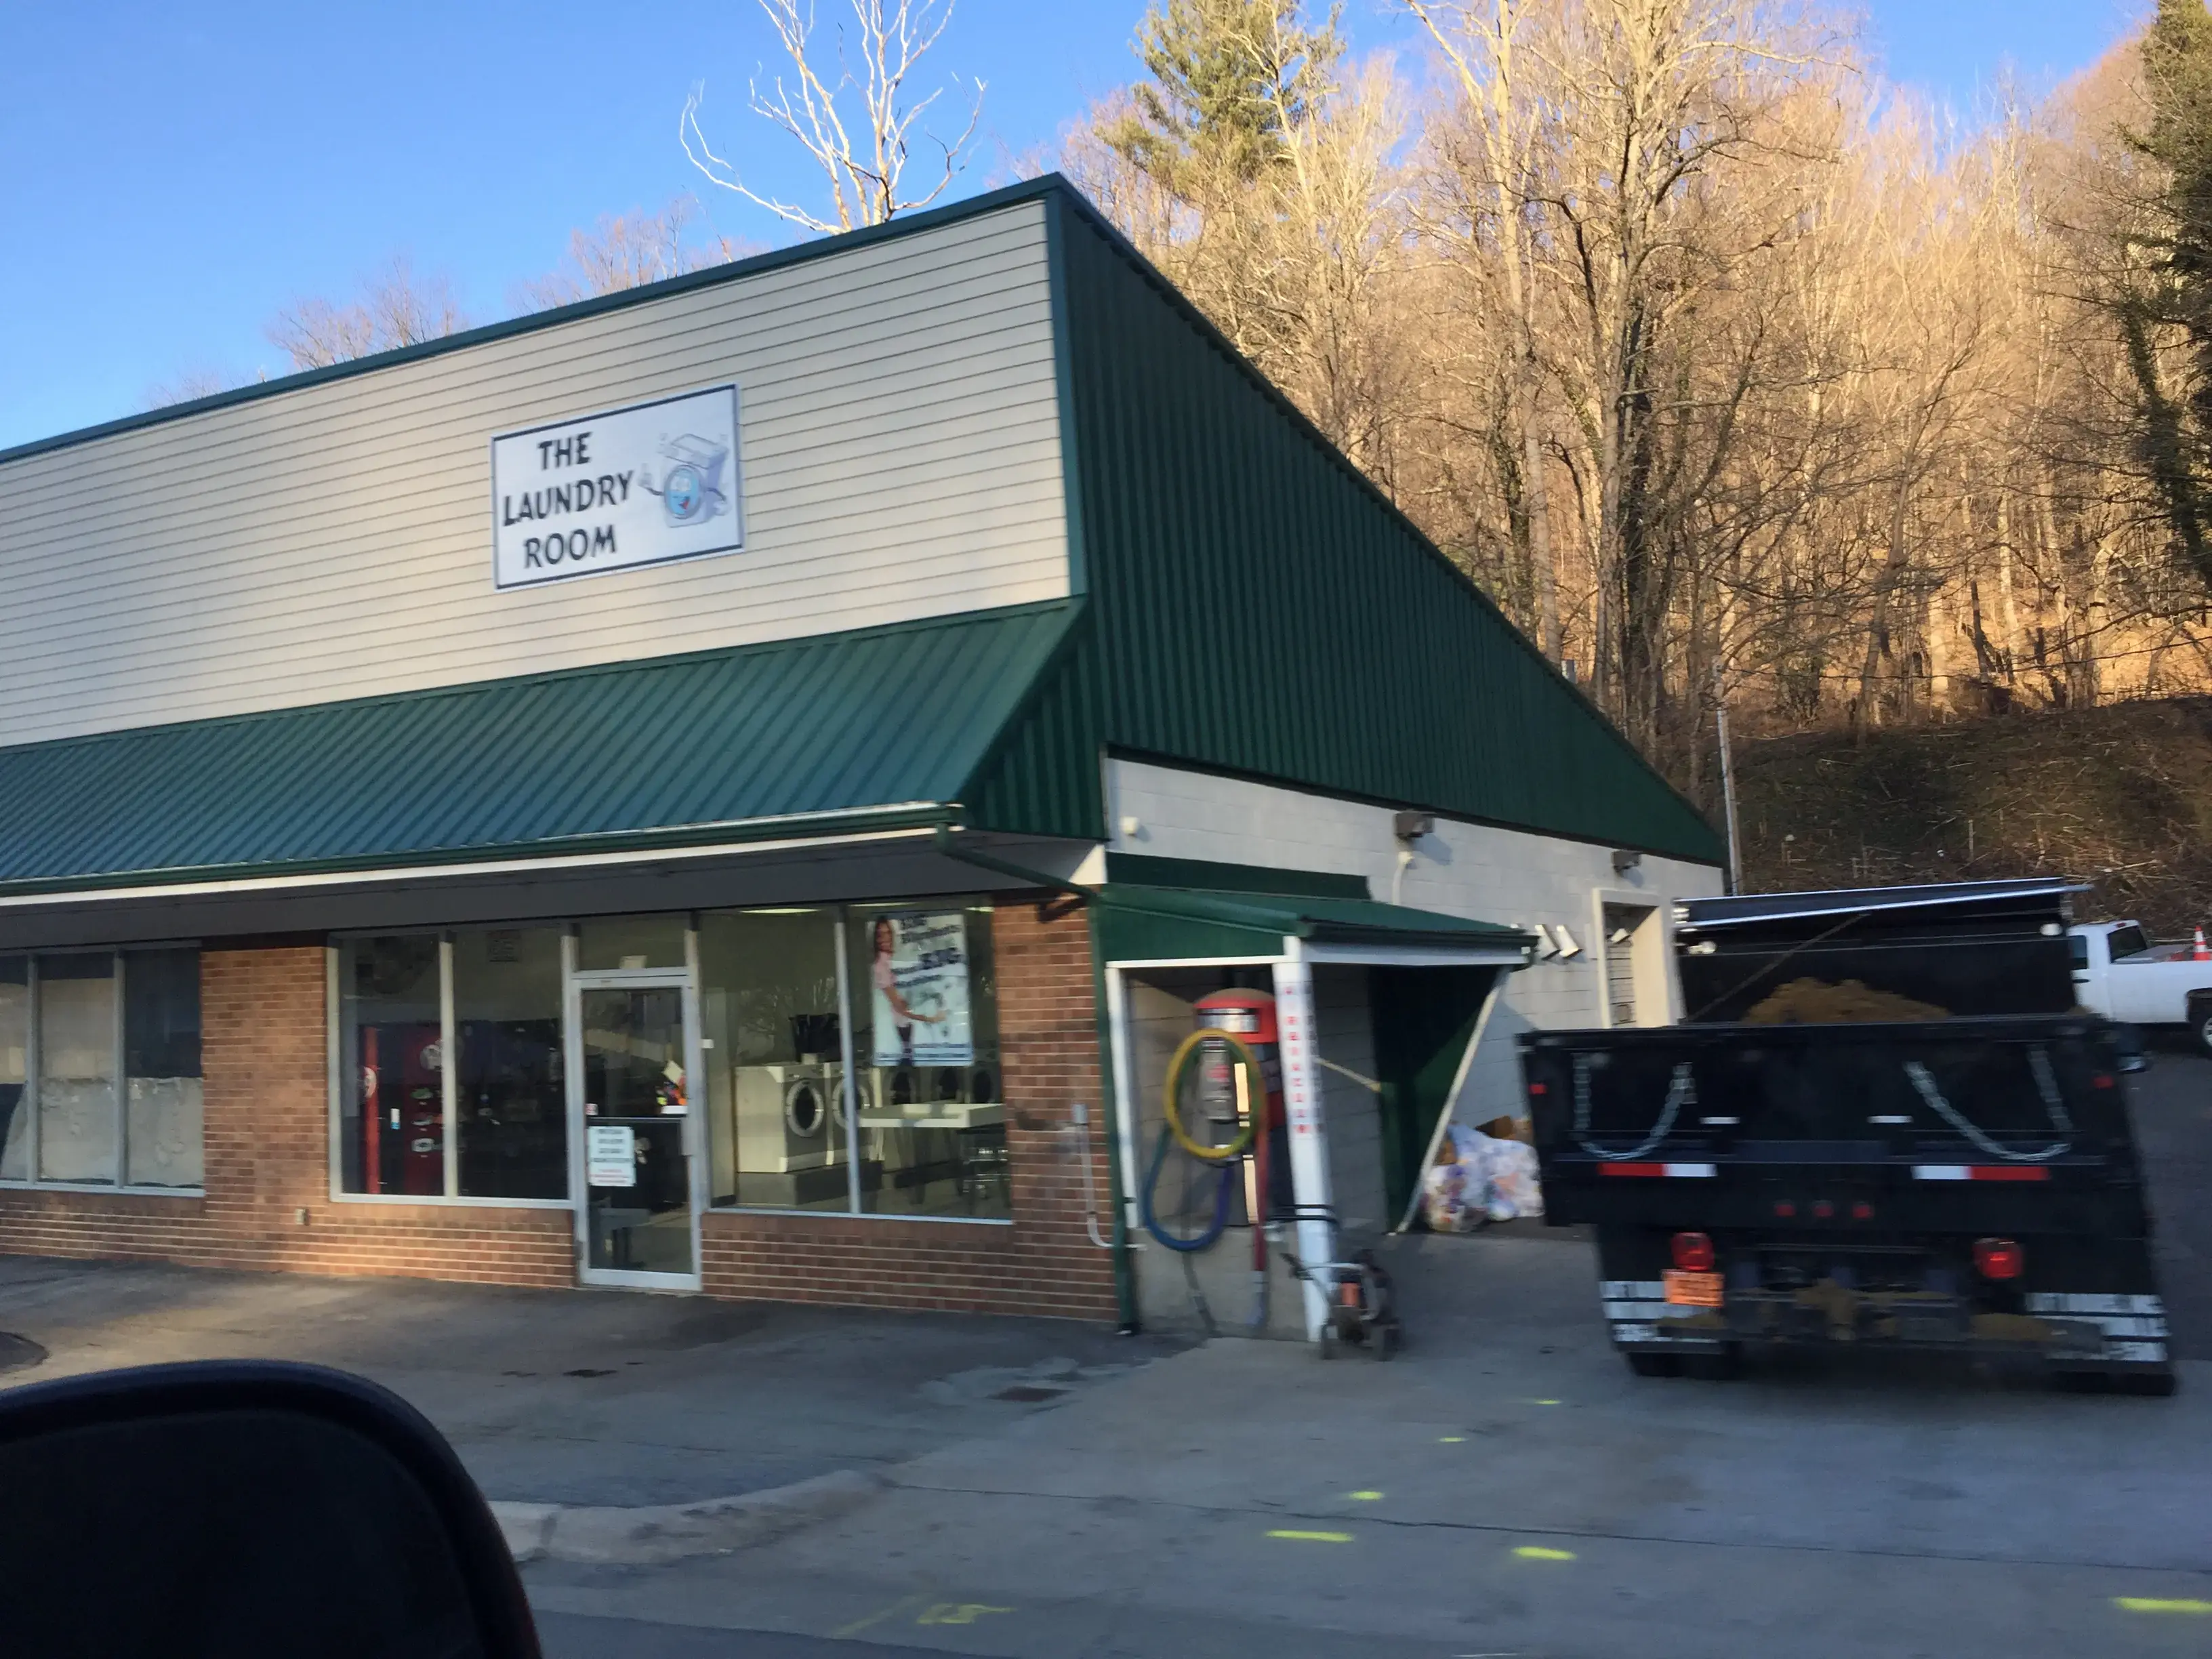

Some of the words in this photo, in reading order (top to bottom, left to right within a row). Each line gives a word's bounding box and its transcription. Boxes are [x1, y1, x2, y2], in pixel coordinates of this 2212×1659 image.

[537, 432, 592, 470] THE
[503, 470, 634, 527] LAUNDRY
[524, 525, 617, 569] ROOM
